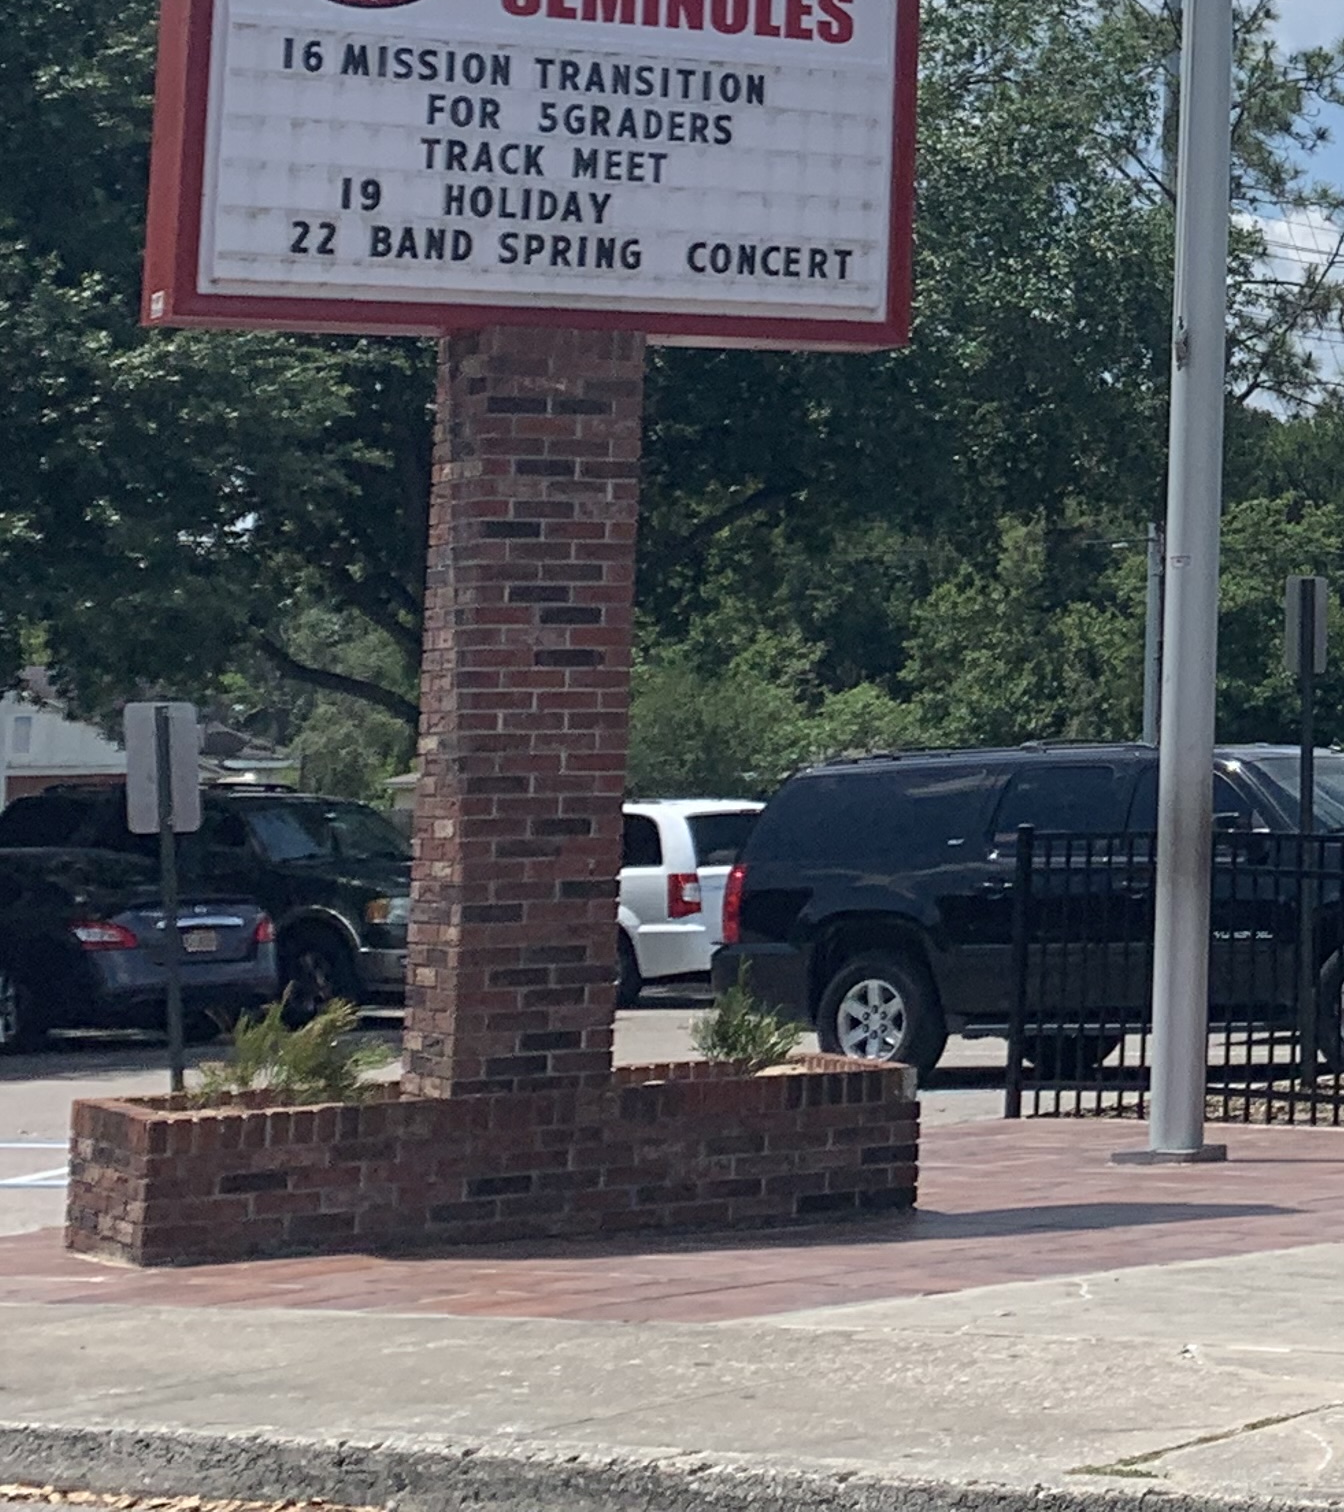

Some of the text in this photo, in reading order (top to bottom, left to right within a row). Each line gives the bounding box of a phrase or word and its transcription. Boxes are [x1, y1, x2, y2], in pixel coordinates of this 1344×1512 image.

[282, 37, 766, 106] 16 MISSION TRANSITION
[426, 93, 734, 145] FOR 5GRADERS
[420, 137, 668, 184] TRACK MEET
[340, 177, 612, 225] 19 HOLIDAY
[290, 220, 854, 280] 22 BAND SPRING CONCERT
